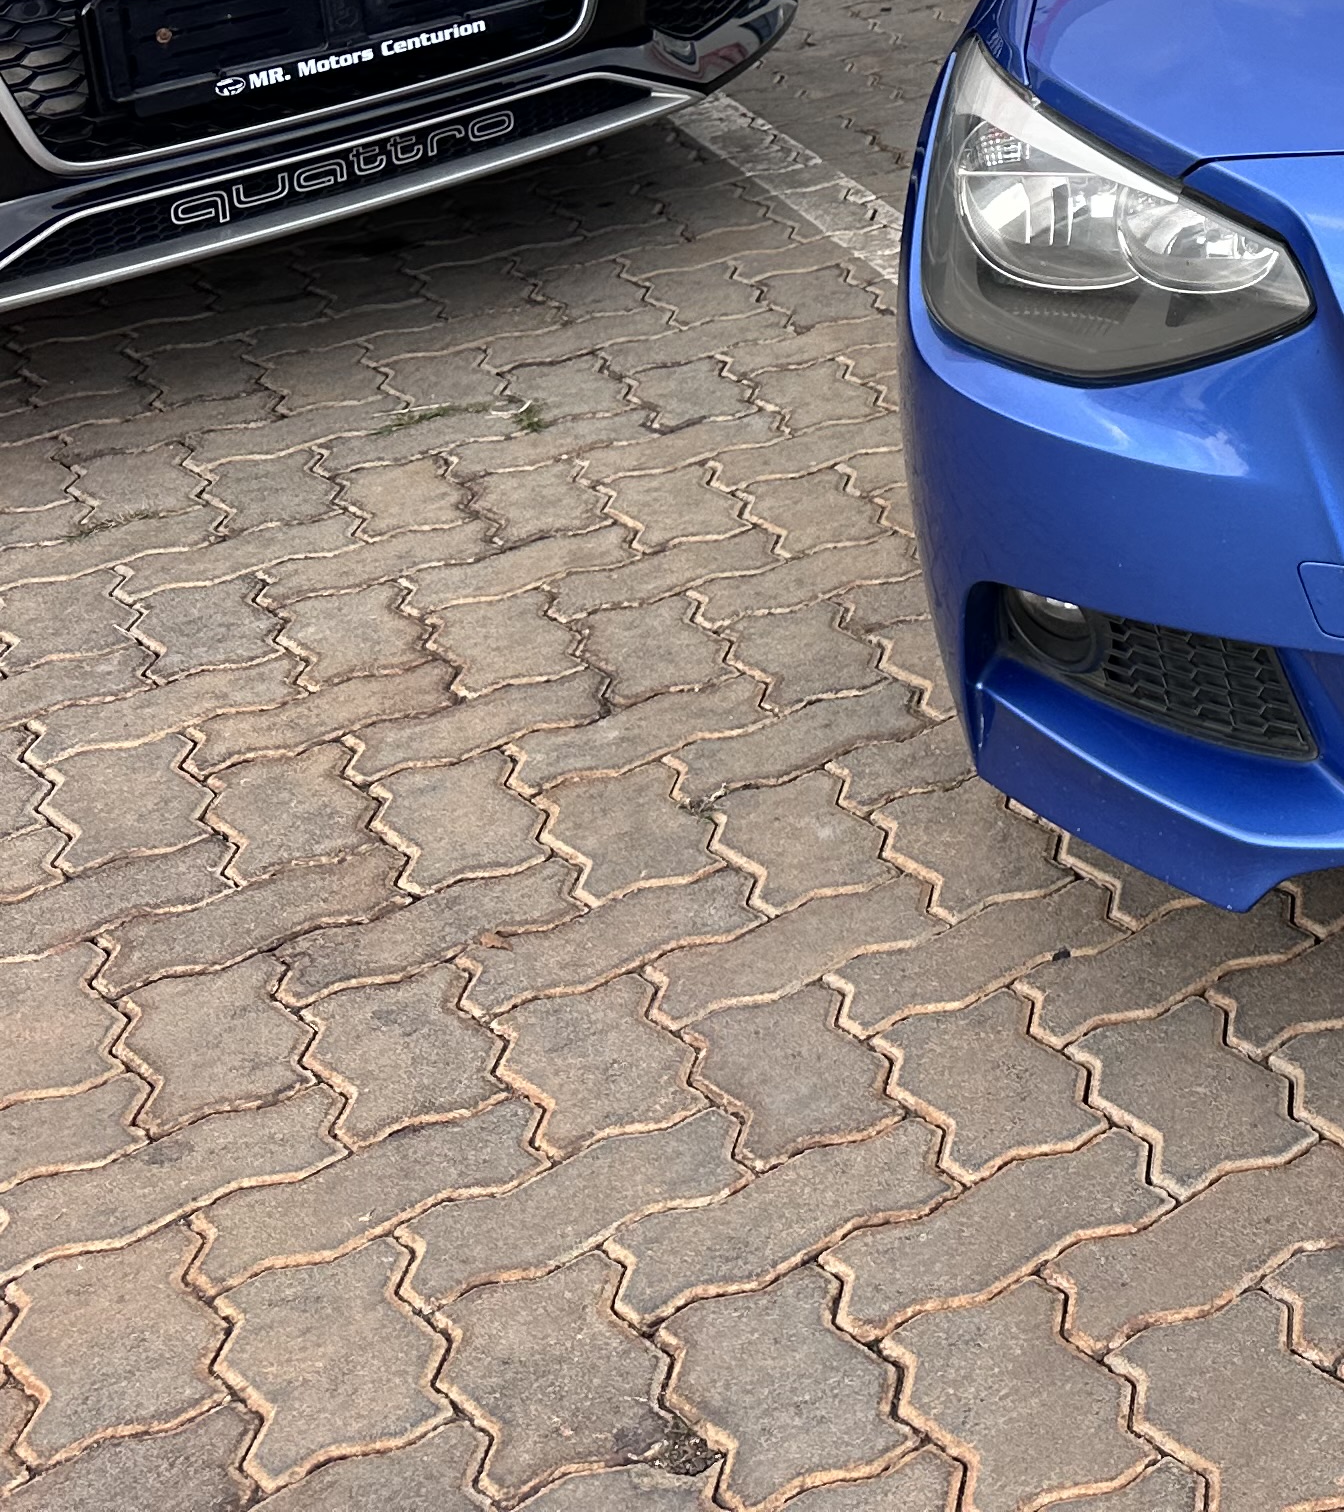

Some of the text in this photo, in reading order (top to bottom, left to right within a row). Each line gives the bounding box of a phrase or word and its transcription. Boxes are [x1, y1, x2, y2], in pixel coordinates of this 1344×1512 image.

[249, 20, 486, 89] MR. Motors Centurion
[171, 110, 514, 225] quattro
